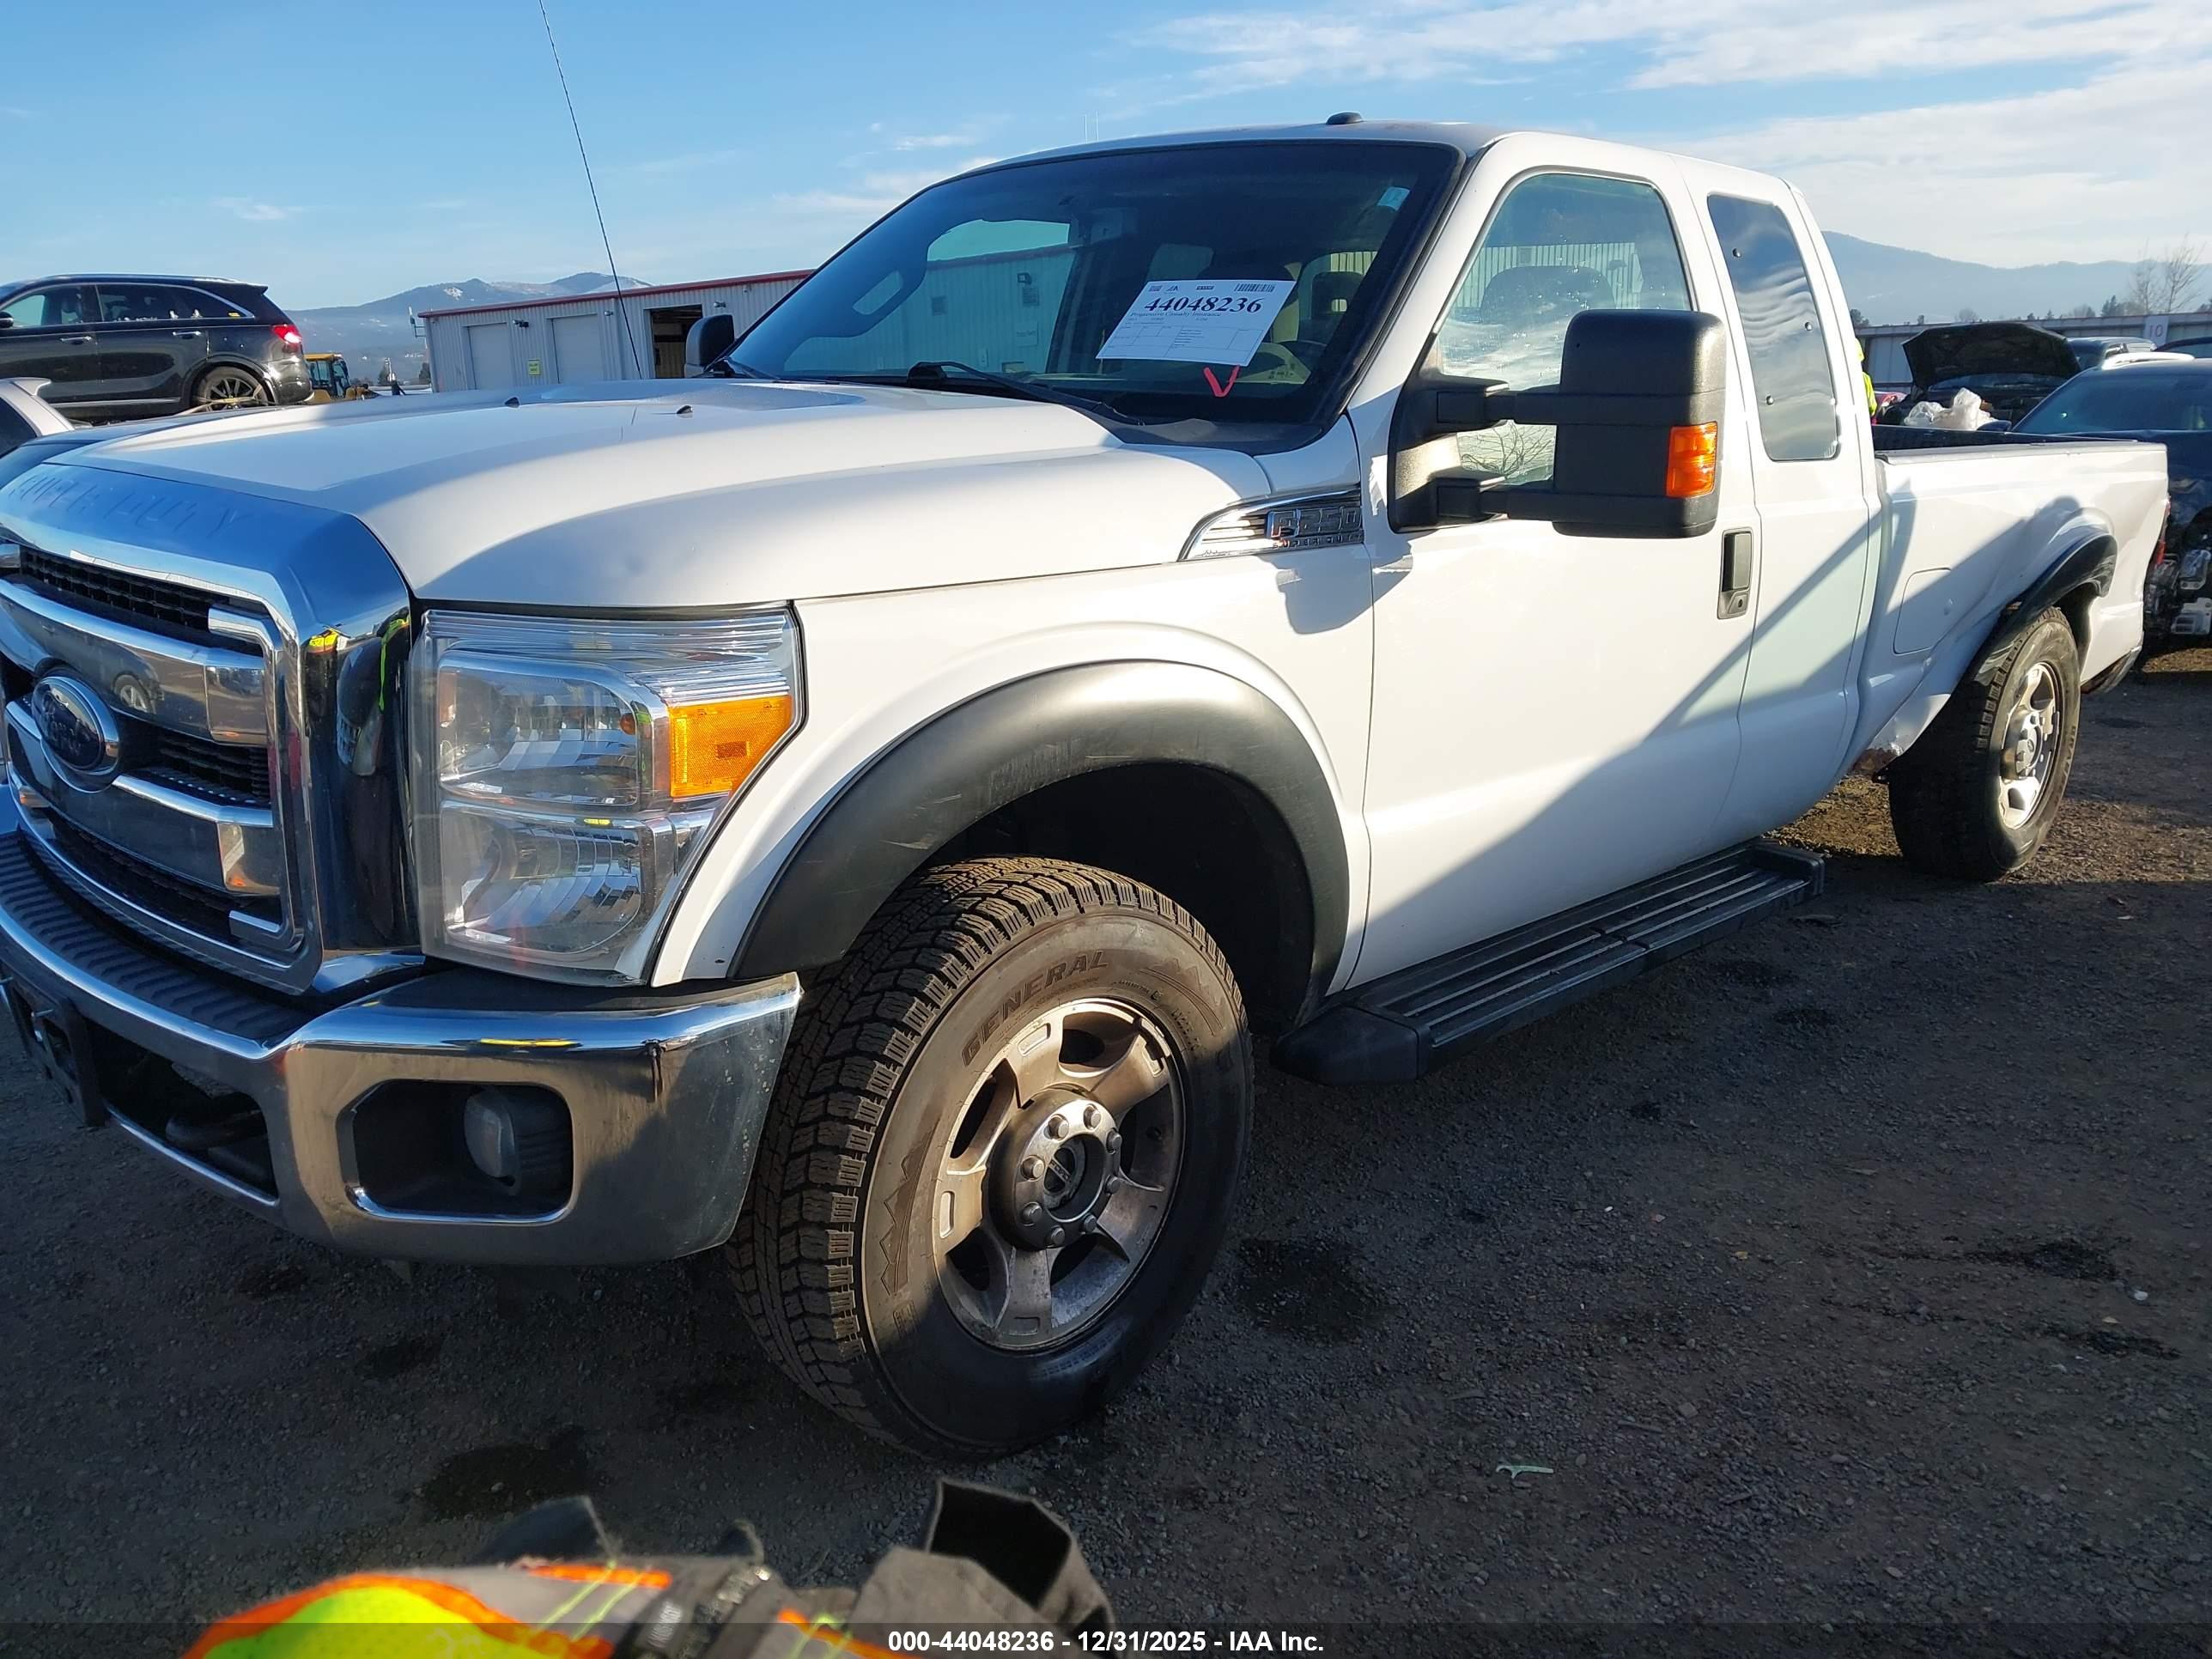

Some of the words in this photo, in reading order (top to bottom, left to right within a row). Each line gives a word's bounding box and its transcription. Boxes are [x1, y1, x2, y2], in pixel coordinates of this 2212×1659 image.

[1145, 296, 1264, 313] 44048236
[2149, 325, 2164, 337] 10
[961, 949, 1109, 1066] GENERAL
